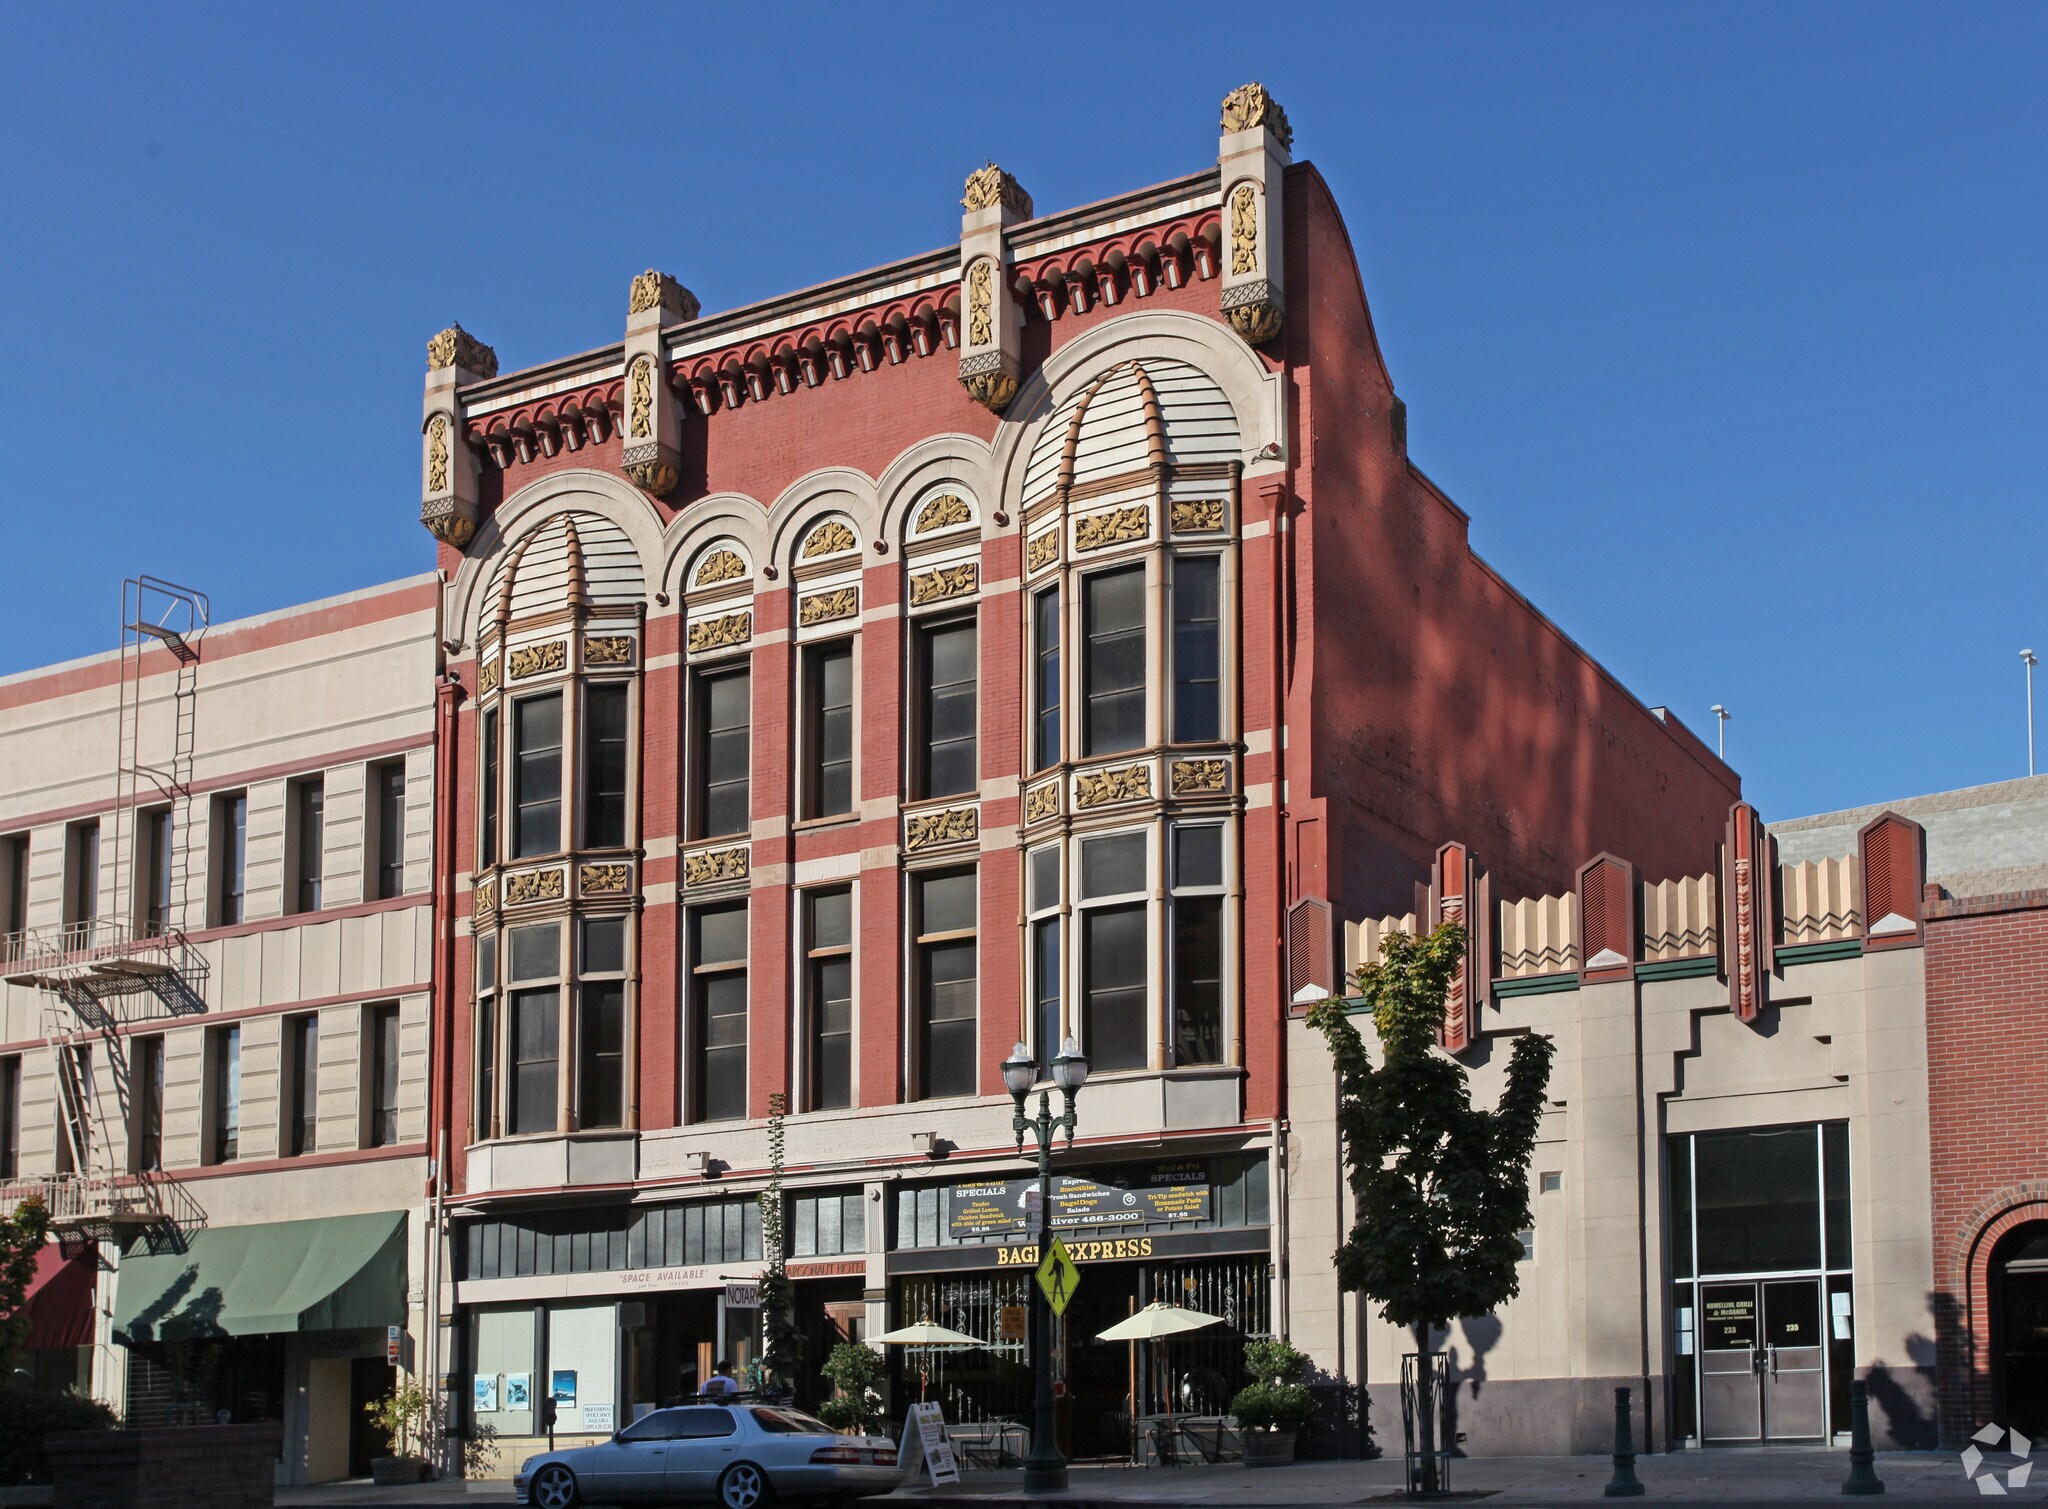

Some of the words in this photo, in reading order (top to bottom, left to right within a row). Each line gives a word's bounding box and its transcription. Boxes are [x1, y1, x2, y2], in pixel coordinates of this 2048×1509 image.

[1151, 1172, 1206, 1182] SPECIALS
[956, 1187, 1006, 1198] SPECIALS
[1060, 1184, 1097, 1192] Smoothies
[1068, 1190, 1110, 1199] Sandwiches
[1050, 1217, 1080, 1225] liver
[1081, 1213, 1138, 1223] 466-3000
[998, 1246, 1039, 1264] BAG
[1064, 1238, 1152, 1260] EXPRESS
[786, 1263, 834, 1277] ARGONAUT
[838, 1261, 866, 1274] HOTEL
[728, 1287, 760, 1304] NOTARY
[1786, 1324, 1799, 1332] 235
